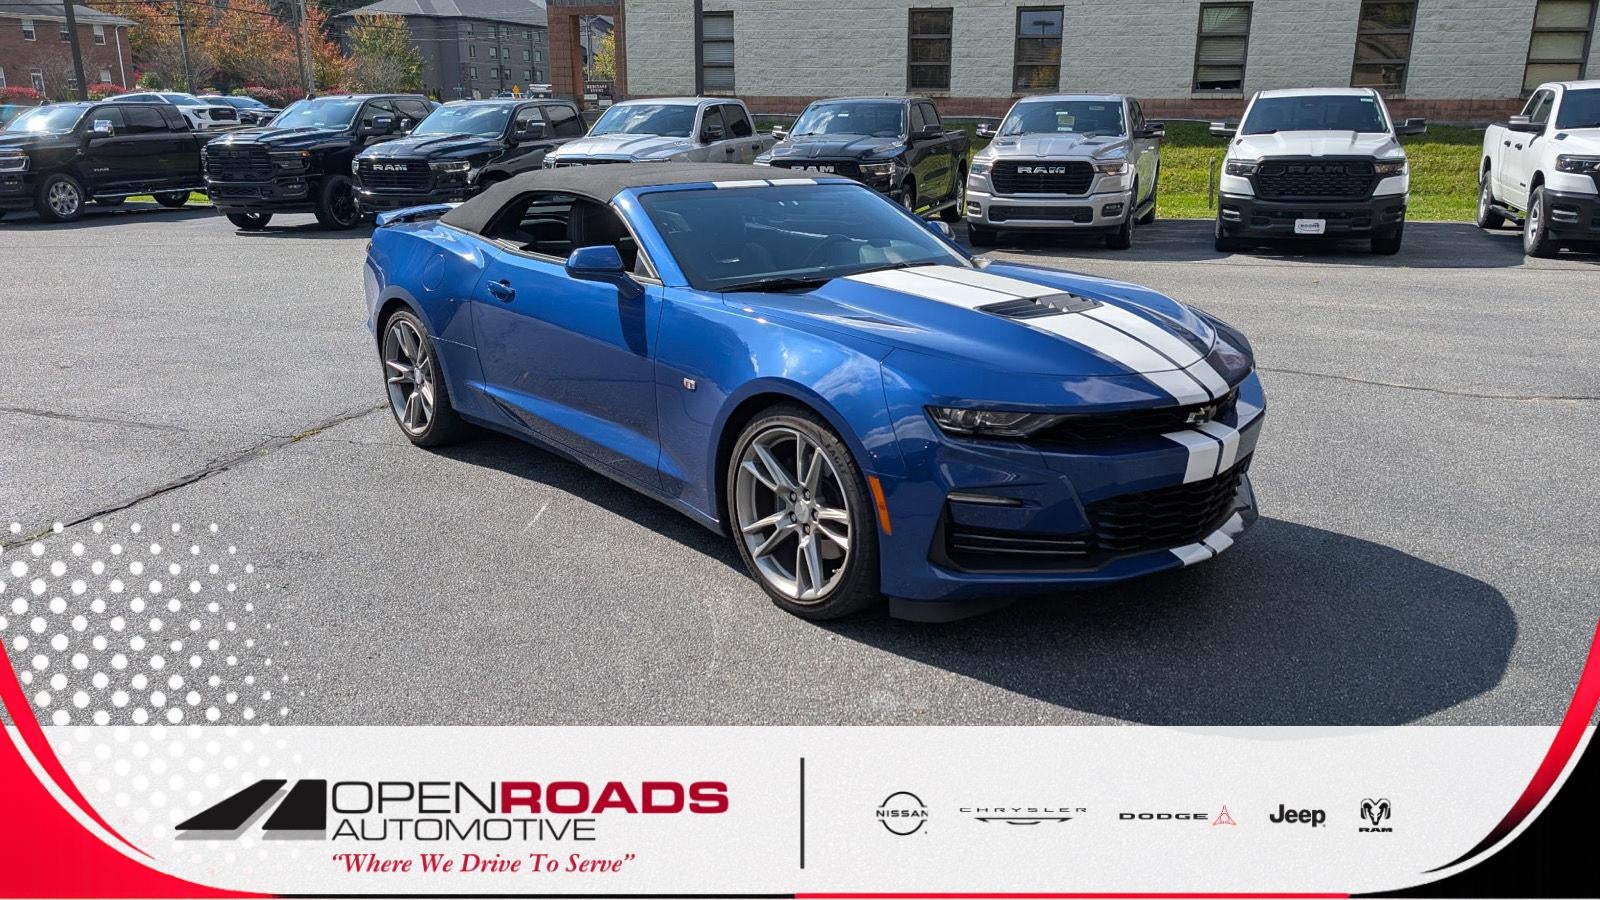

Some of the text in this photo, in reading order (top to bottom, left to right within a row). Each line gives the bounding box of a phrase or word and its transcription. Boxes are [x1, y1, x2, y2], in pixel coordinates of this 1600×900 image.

[372, 163, 408, 172] RAM
[790, 165, 835, 173] RAM
[1017, 166, 1066, 175] RAM
[1287, 165, 1345, 175] RAM
